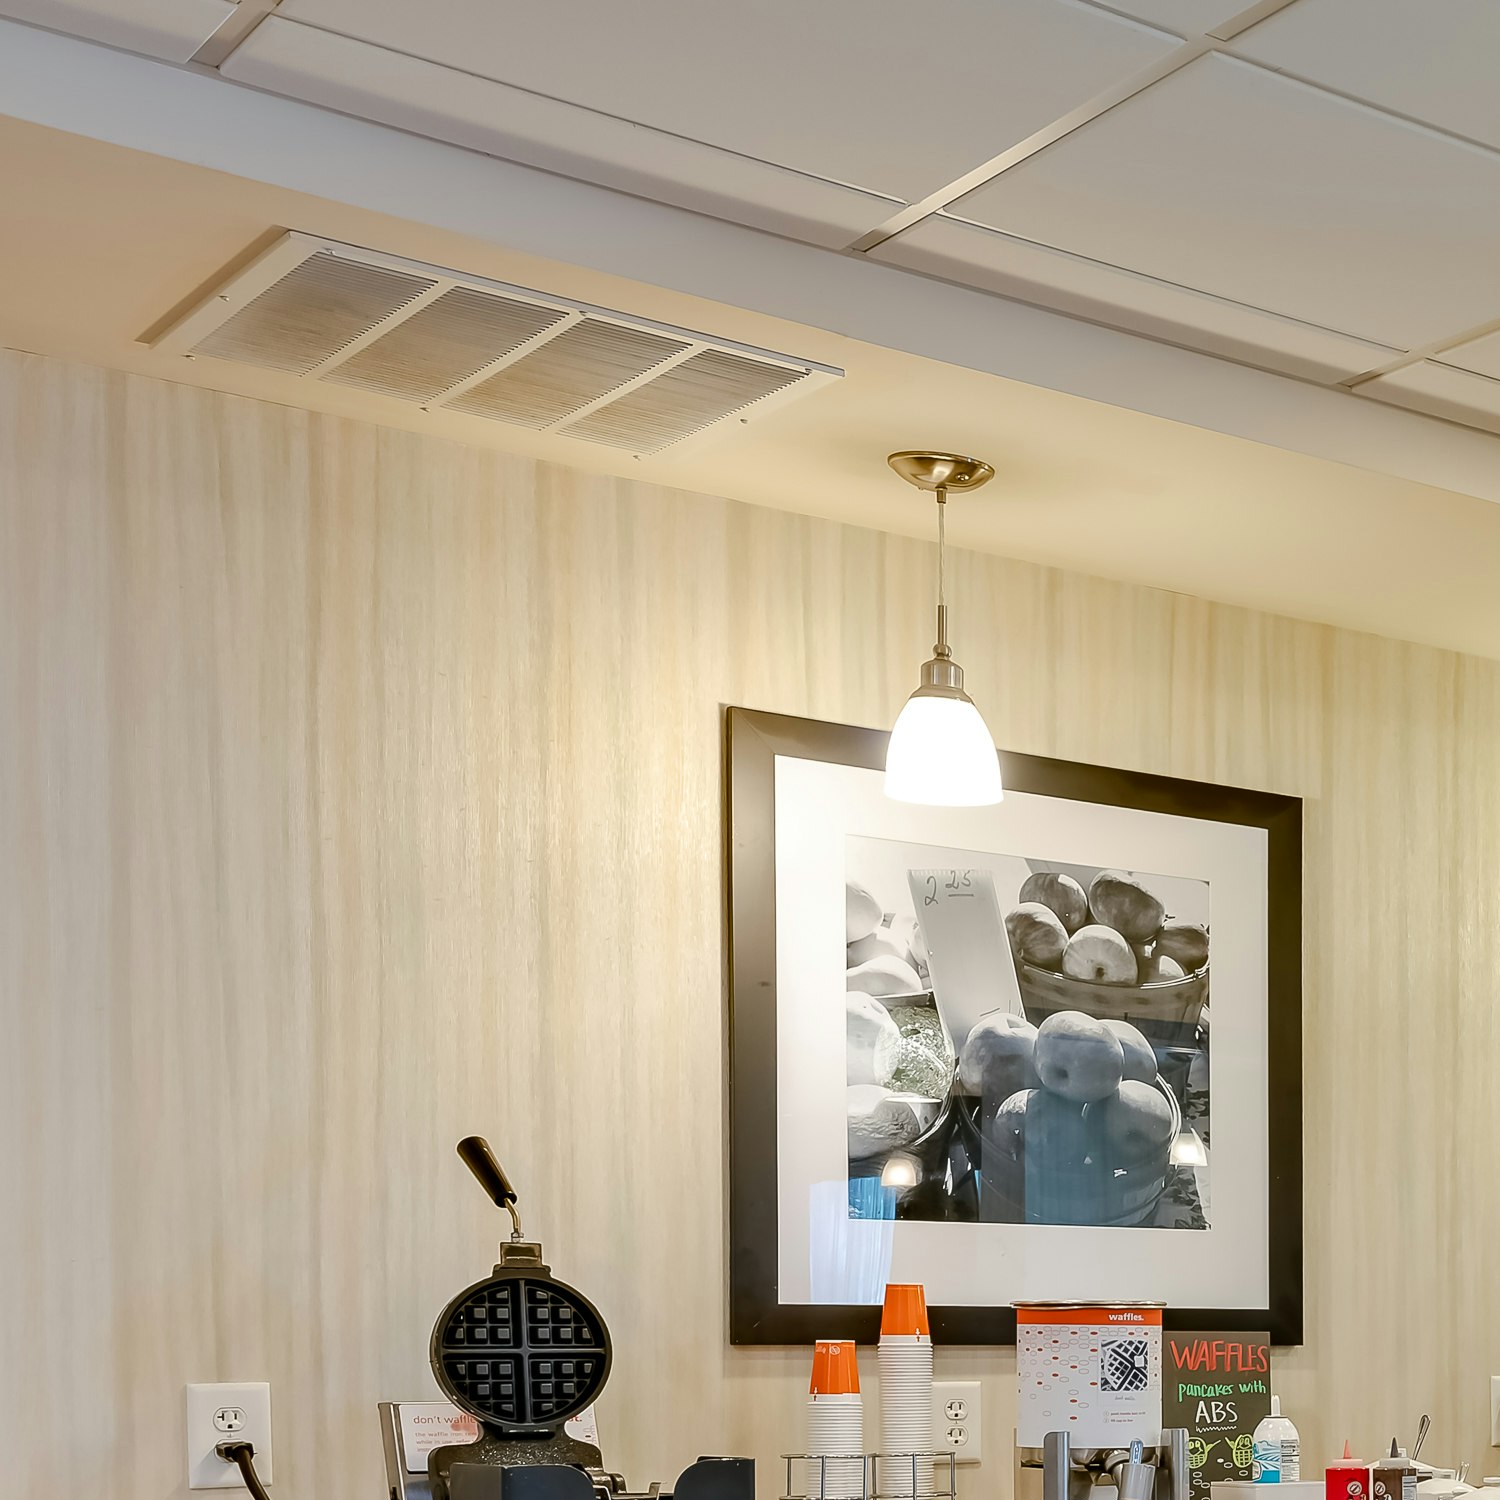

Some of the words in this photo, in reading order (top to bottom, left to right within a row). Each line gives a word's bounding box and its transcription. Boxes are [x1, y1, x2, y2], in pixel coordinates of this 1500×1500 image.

[1108, 1312, 1145, 1322] waffles.
[1170, 1338, 1268, 1373] WAFFLES
[1178, 1382, 1234, 1402] pancakes
[1239, 1380, 1267, 1394] with
[413, 1415, 441, 1424] don't
[1195, 1400, 1238, 1424] ABS
